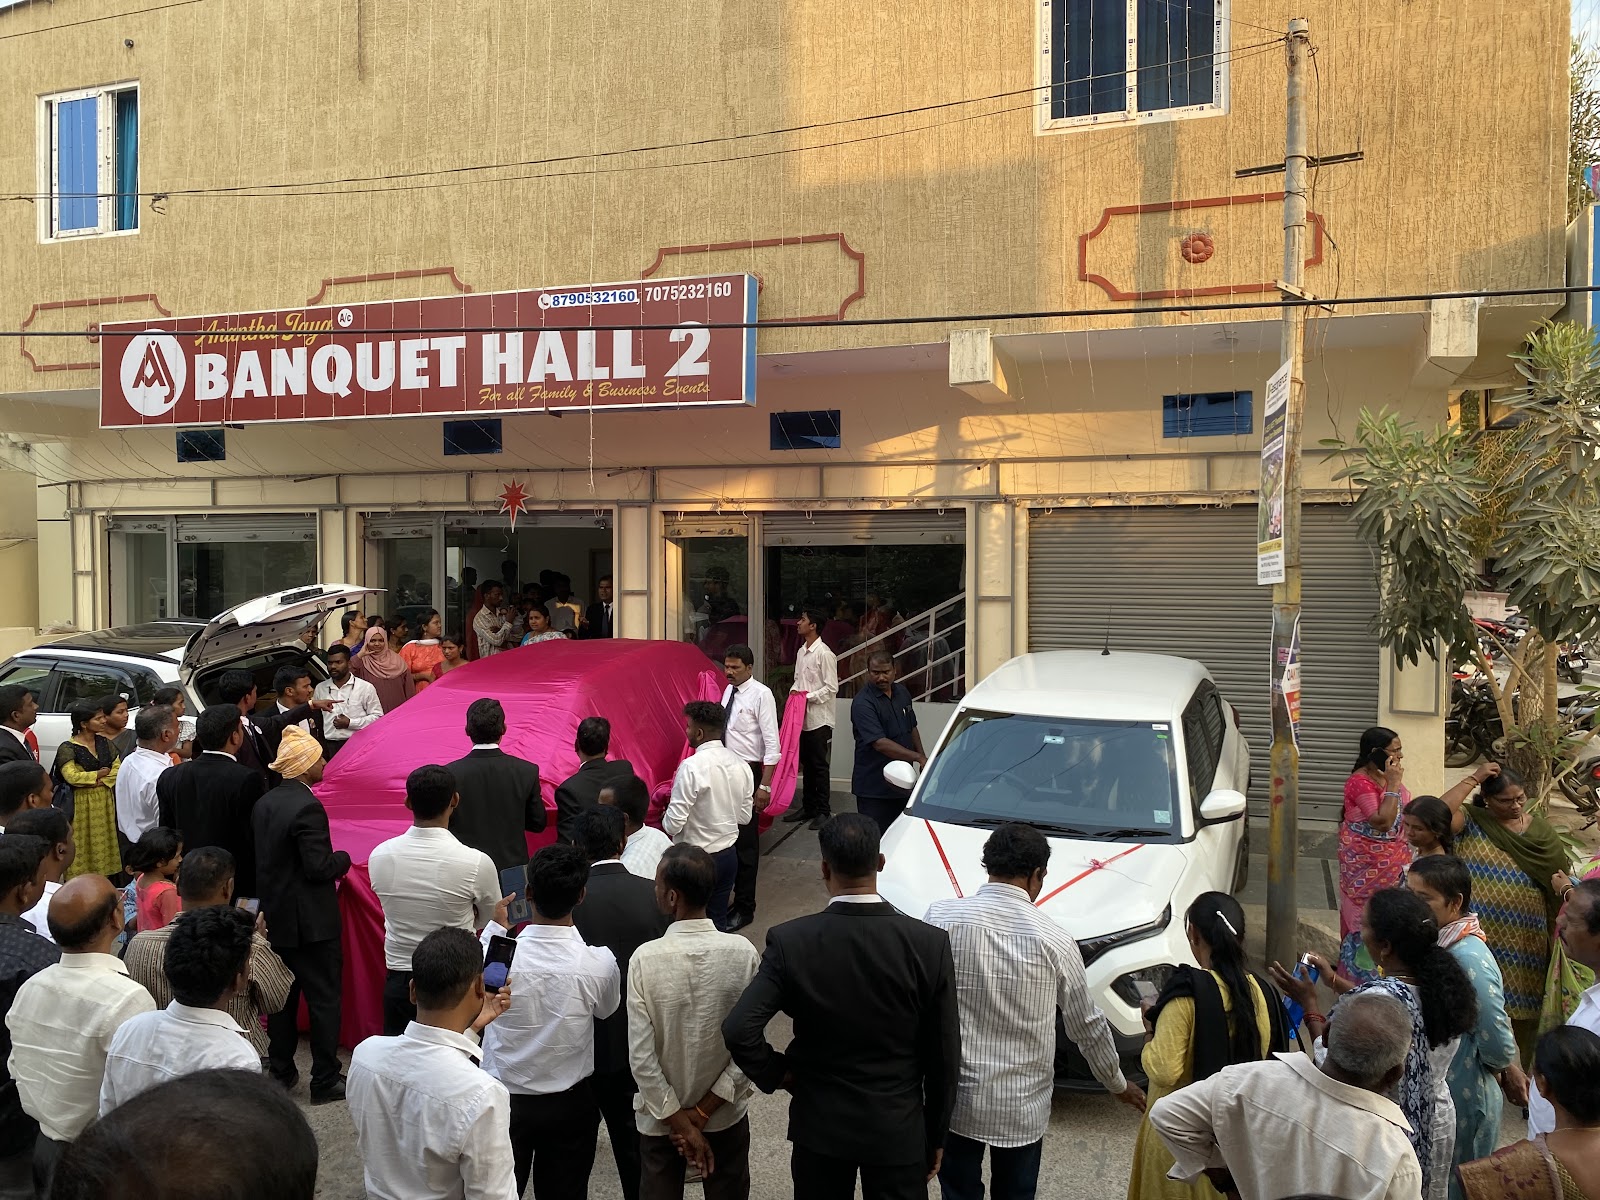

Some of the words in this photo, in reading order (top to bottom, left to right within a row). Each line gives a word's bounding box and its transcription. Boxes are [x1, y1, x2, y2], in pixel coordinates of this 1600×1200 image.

[645, 282, 732, 302] 7075232160
[194, 316, 277, 346] Anantha
[281, 312, 333, 346] Jaya
[194, 335, 466, 401] BANQUET
[482, 329, 646, 385] HALL
[664, 321, 711, 377] 2
[479, 387, 502, 406] For
[506, 387, 525, 401] all
[529, 385, 577, 402] Family
[598, 381, 656, 397] Business
[663, 378, 710, 396] Events
